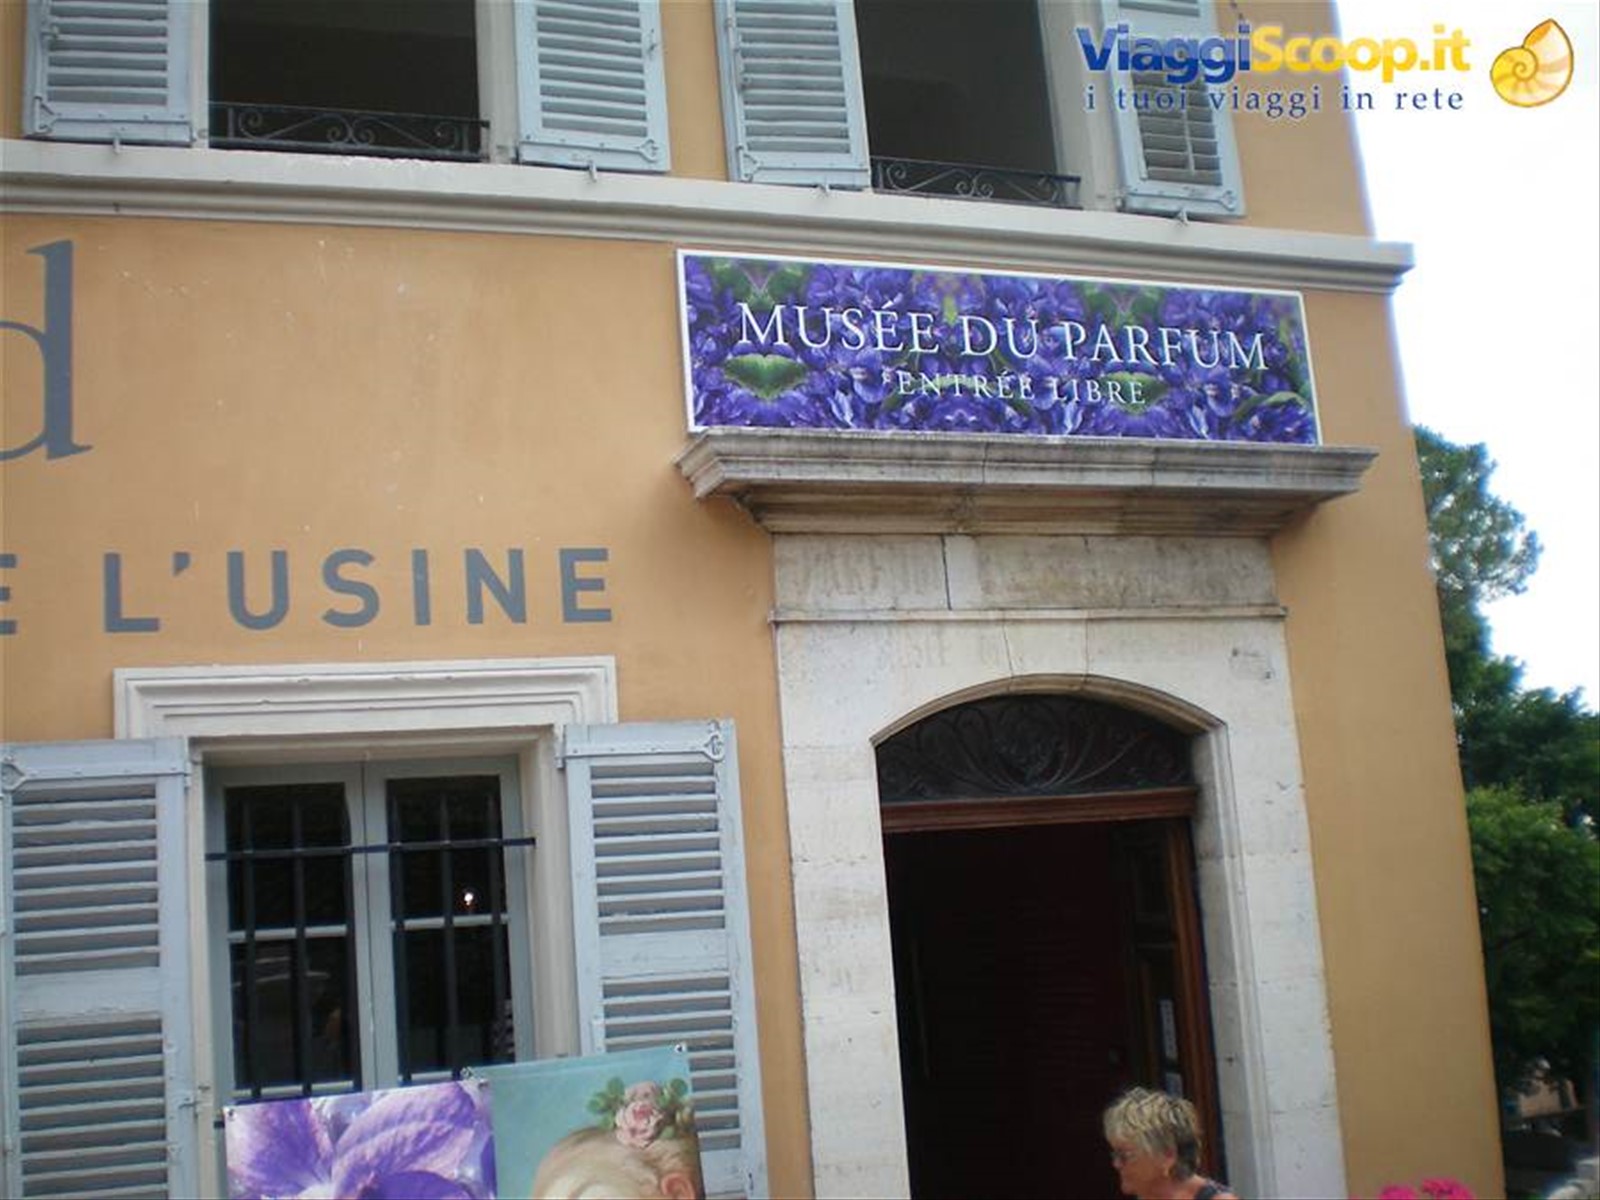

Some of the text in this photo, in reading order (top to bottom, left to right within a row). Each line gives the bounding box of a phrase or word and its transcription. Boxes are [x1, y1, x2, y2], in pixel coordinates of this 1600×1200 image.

[737, 294, 1270, 371] MUSÉE DU PARFUM
[897, 369, 1146, 405] ENTRÉE LIBRE
[103, 547, 613, 633] L'USINE
